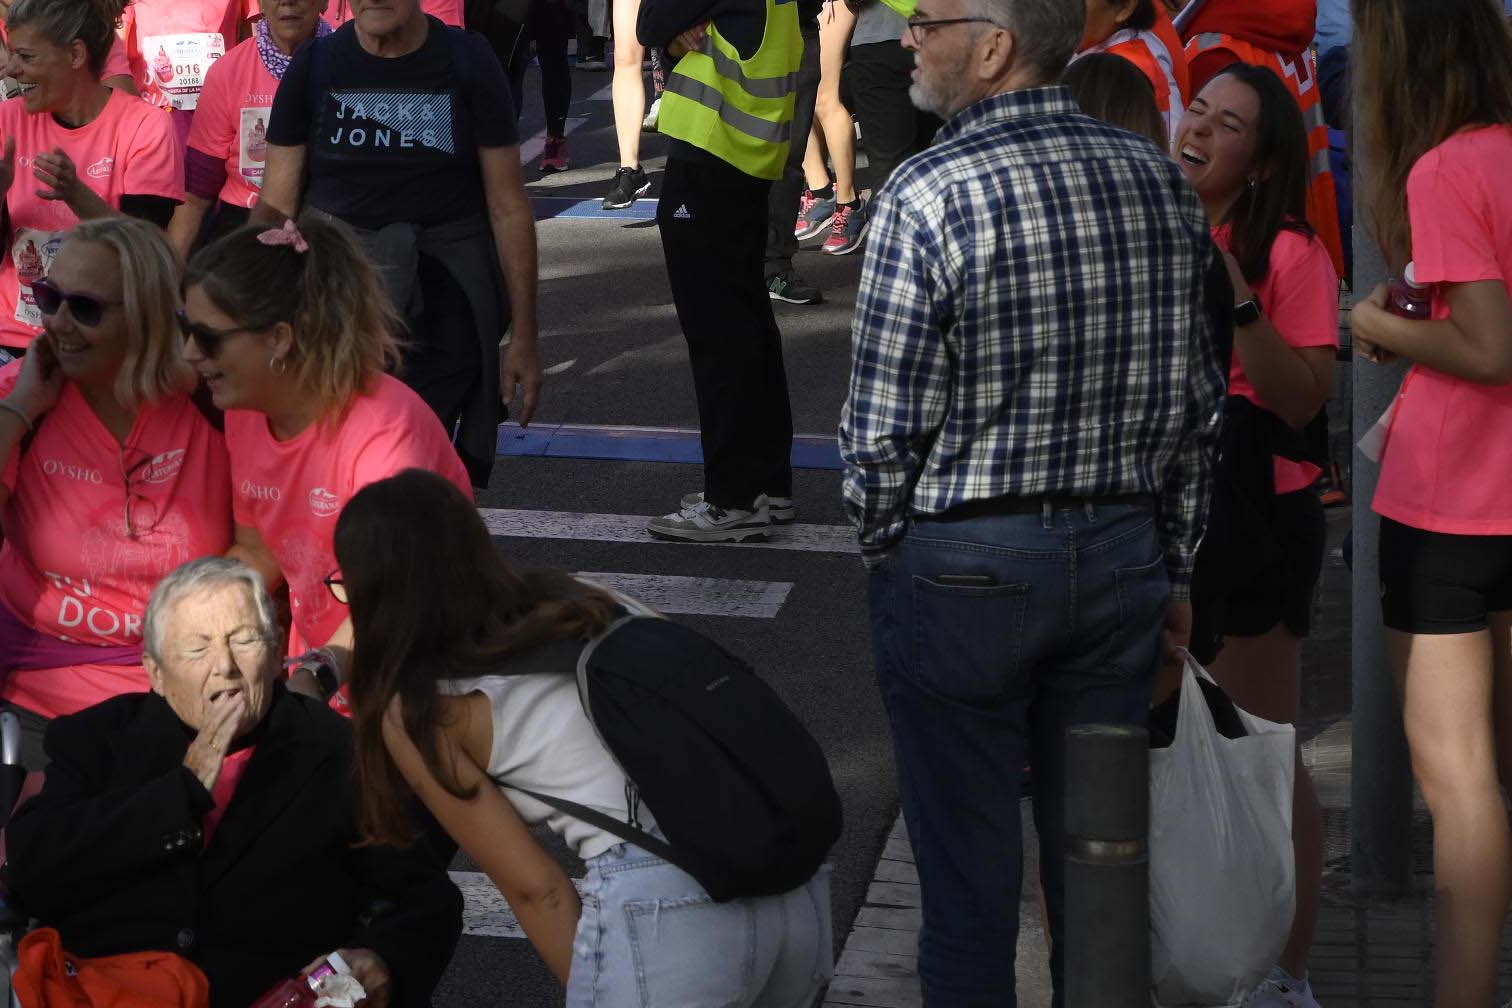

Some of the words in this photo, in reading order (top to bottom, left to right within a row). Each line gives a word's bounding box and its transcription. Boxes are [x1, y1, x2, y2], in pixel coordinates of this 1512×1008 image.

[175, 63, 200, 75] 016
[330, 127, 437, 148] JONES
[43, 458, 104, 486] OYSHO
[58, 596, 144, 640] DOR
